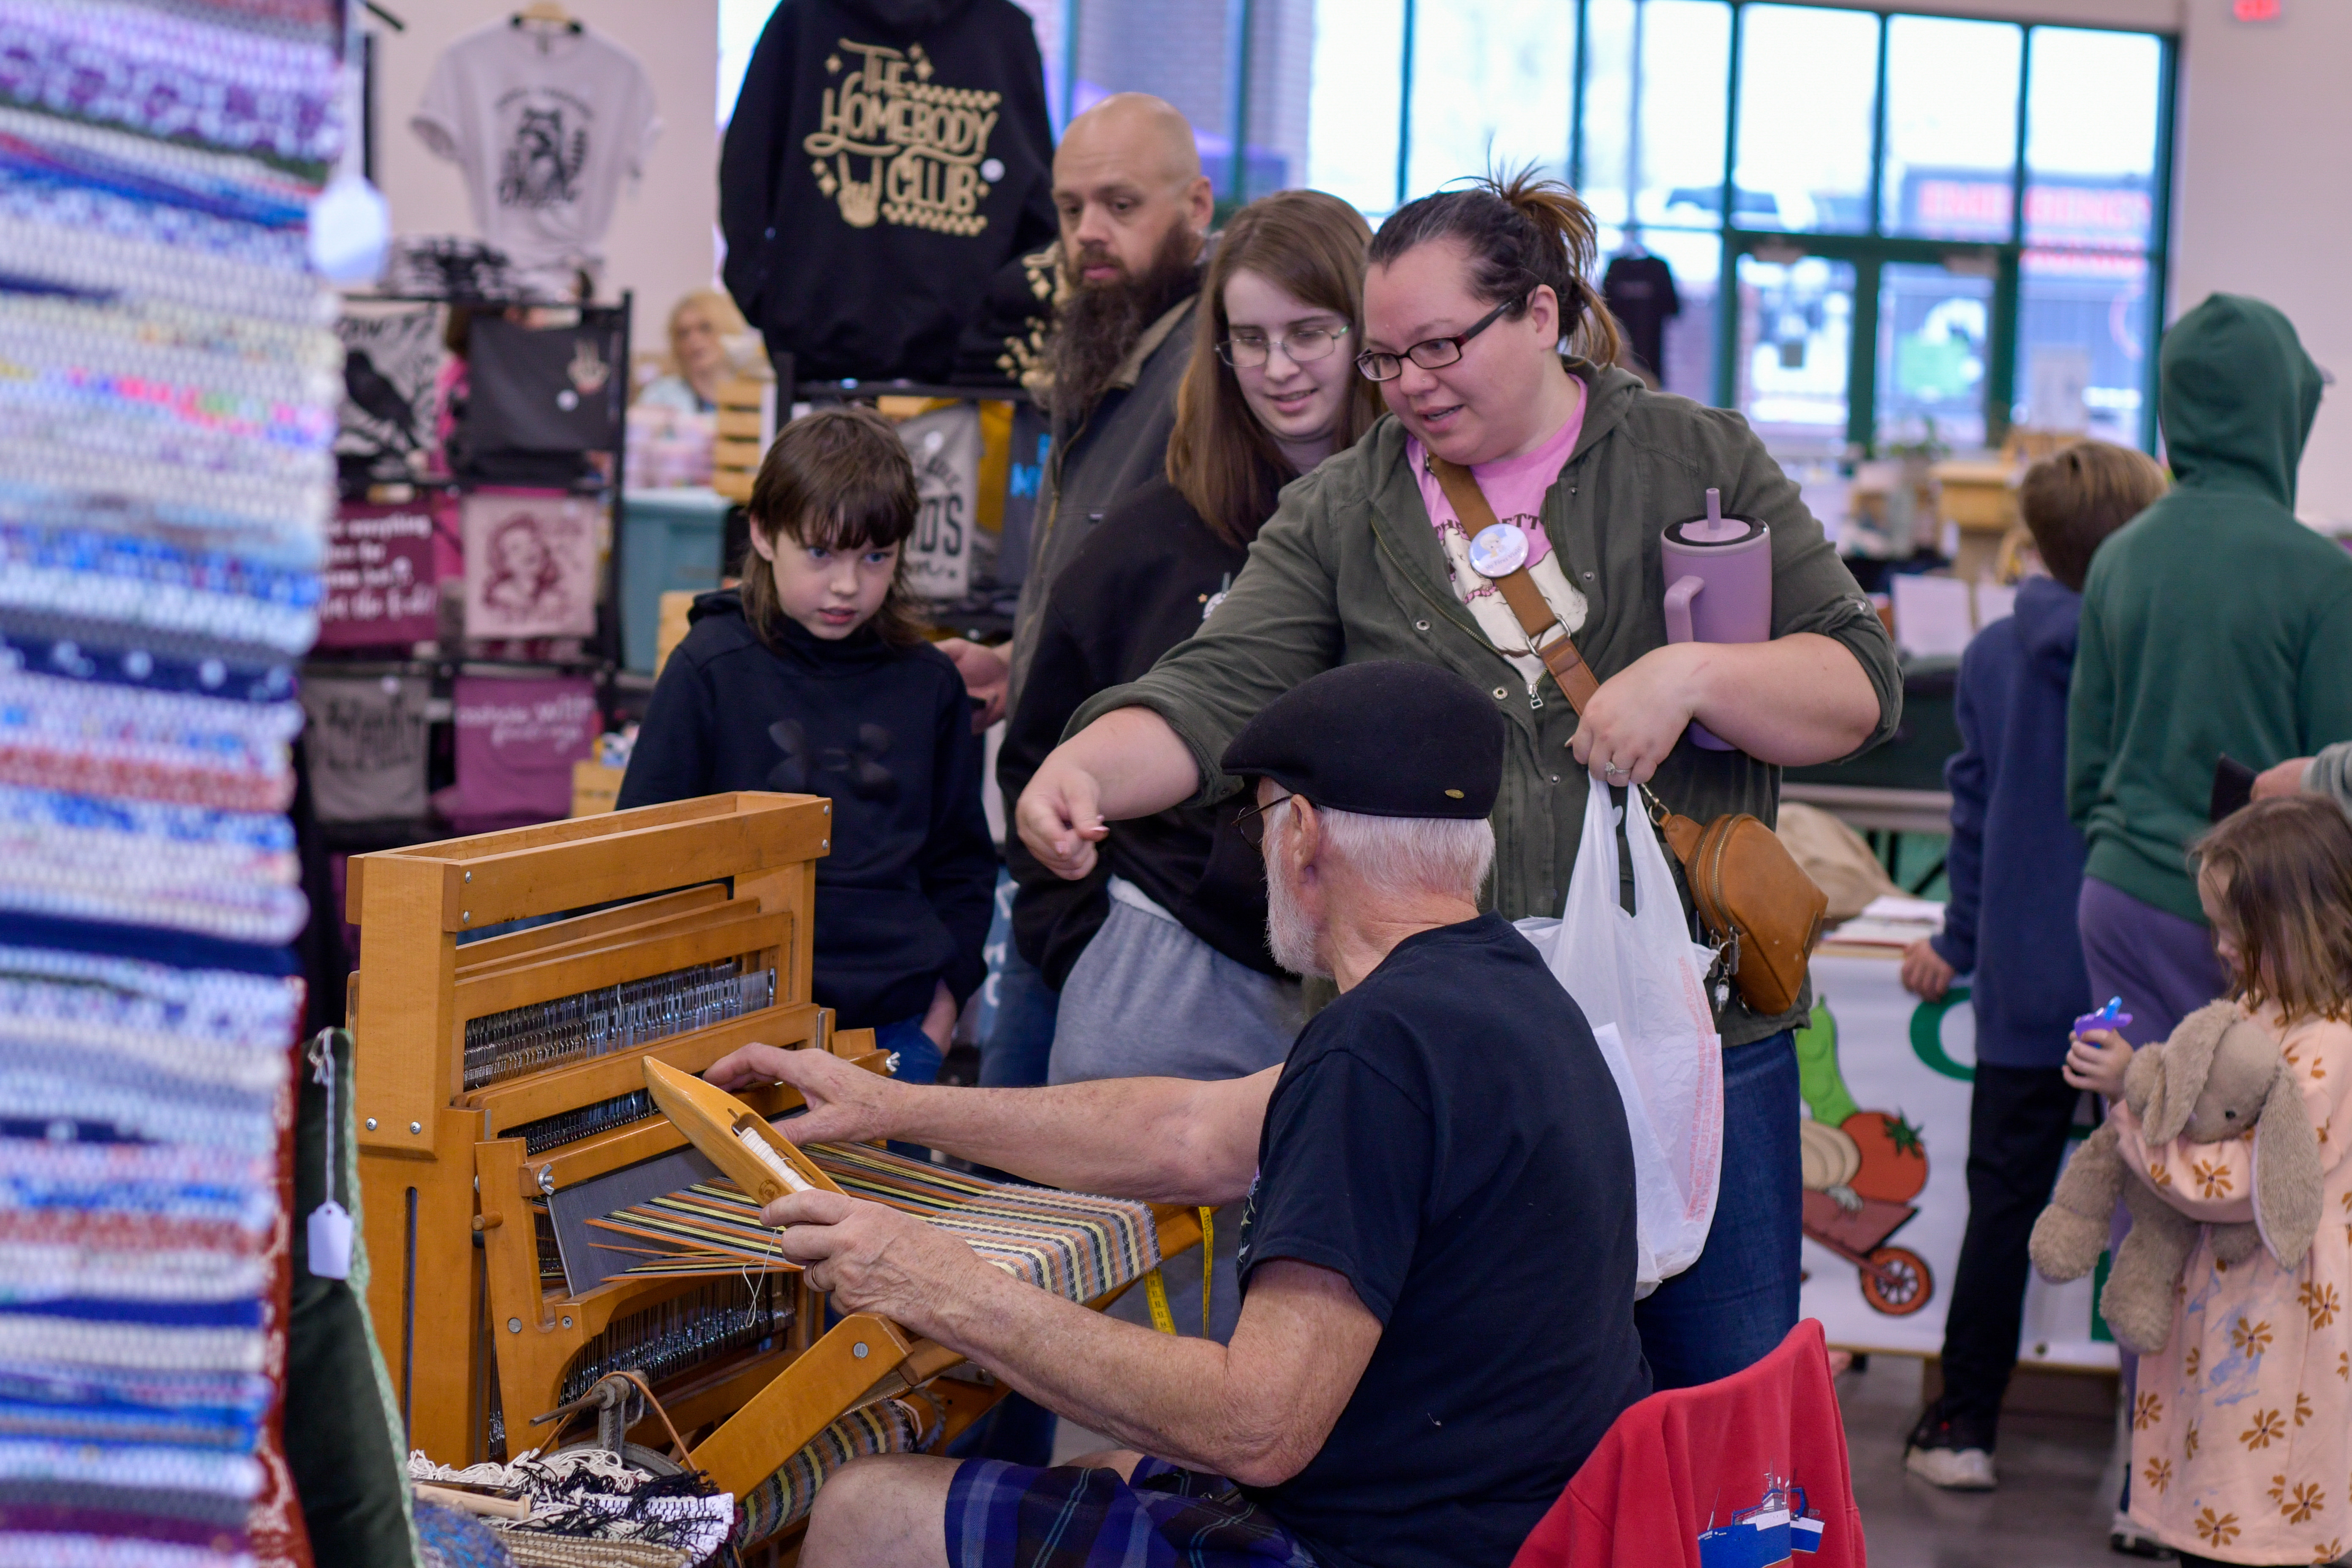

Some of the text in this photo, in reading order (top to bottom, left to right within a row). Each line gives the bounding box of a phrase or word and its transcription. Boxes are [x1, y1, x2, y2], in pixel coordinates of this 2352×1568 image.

[839, 38, 910, 95] THE
[804, 70, 999, 165] HOMEBODY
[886, 155, 979, 214] CLUB
